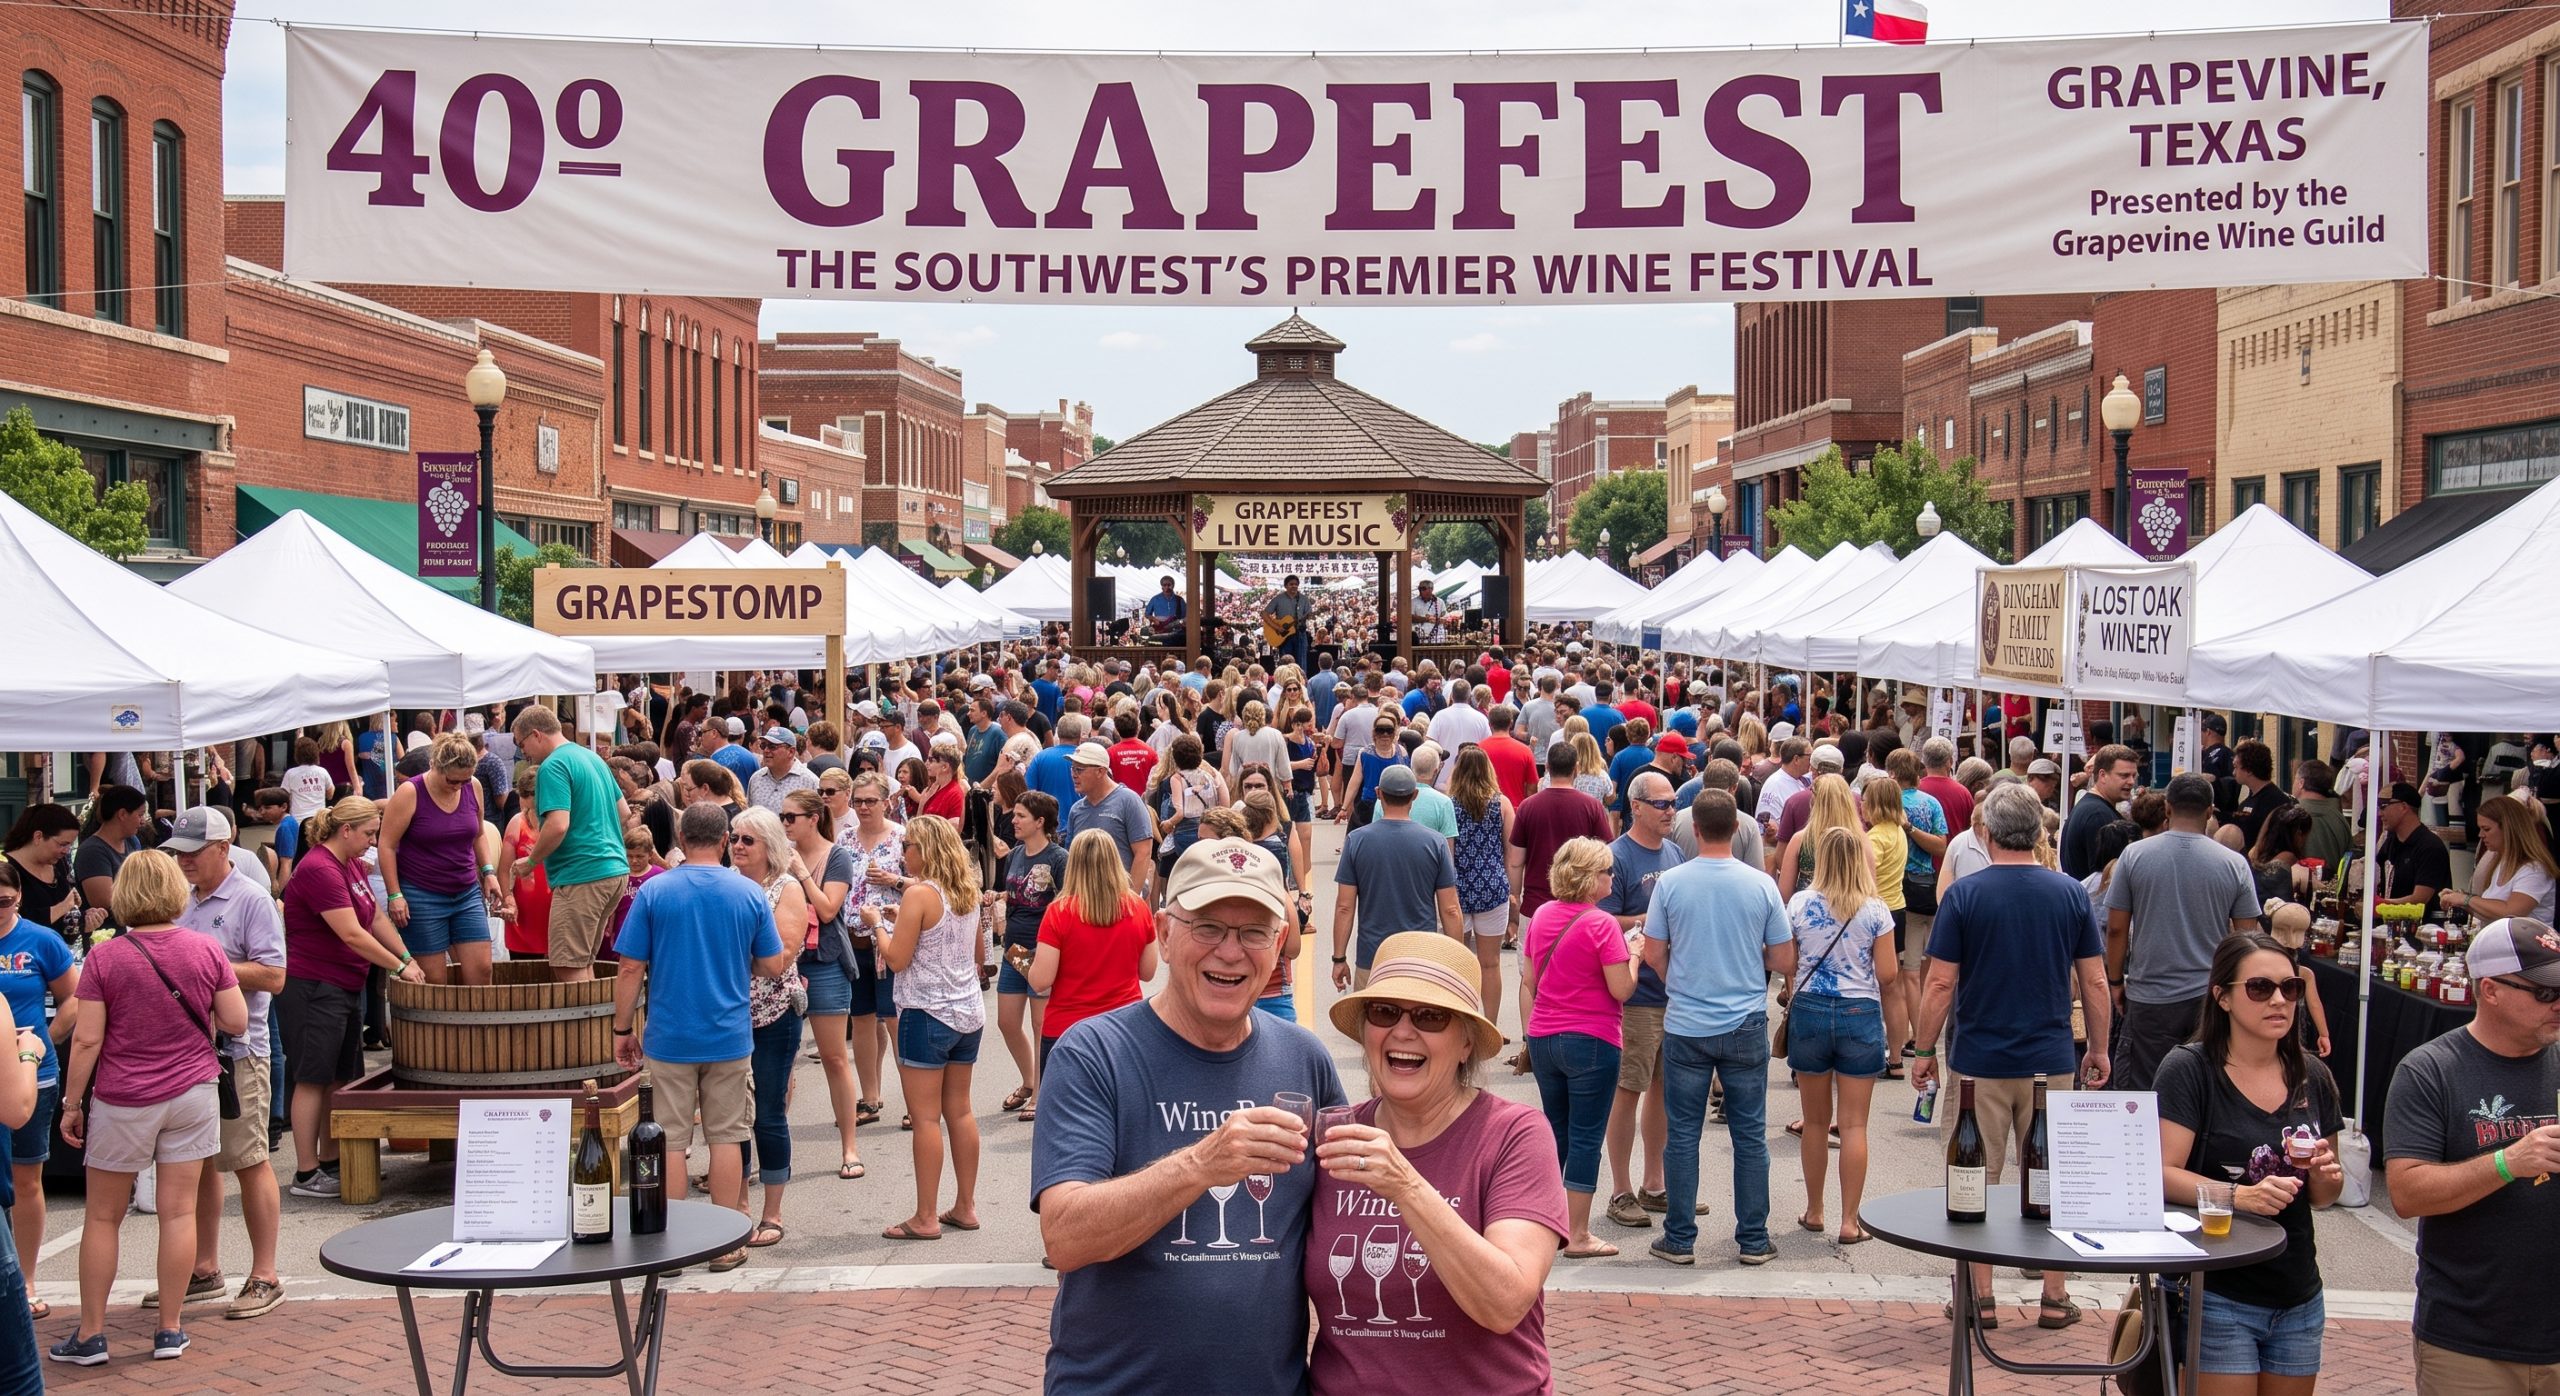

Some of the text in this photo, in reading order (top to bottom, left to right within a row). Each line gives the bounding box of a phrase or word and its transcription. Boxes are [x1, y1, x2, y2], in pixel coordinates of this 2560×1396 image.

[2048, 52, 2387, 110] GRAPEVINE,
[763, 72, 1942, 230] GRAPEFEST
[2130, 116, 2307, 167] TEXAS
[2090, 178, 2348, 216] Presented by the
[2053, 215, 2385, 262] Grapevine Wine Guild
[777, 247, 1933, 296] THE SOUTHWEST'S PREMIER WINE FESTIVAL
[1235, 501, 1363, 520] GRAPEFEST
[1218, 523, 1381, 547] LIVE MUSIC
[556, 584, 823, 621] GRAPESTOMP
[2003, 582, 2061, 610] BINGHAM
[2092, 585, 2183, 618] LOST OAK
[2009, 614, 2051, 641] FAMILY
[2100, 621, 2172, 655] WINERY
[2002, 644, 2055, 669] VINEYARDS
